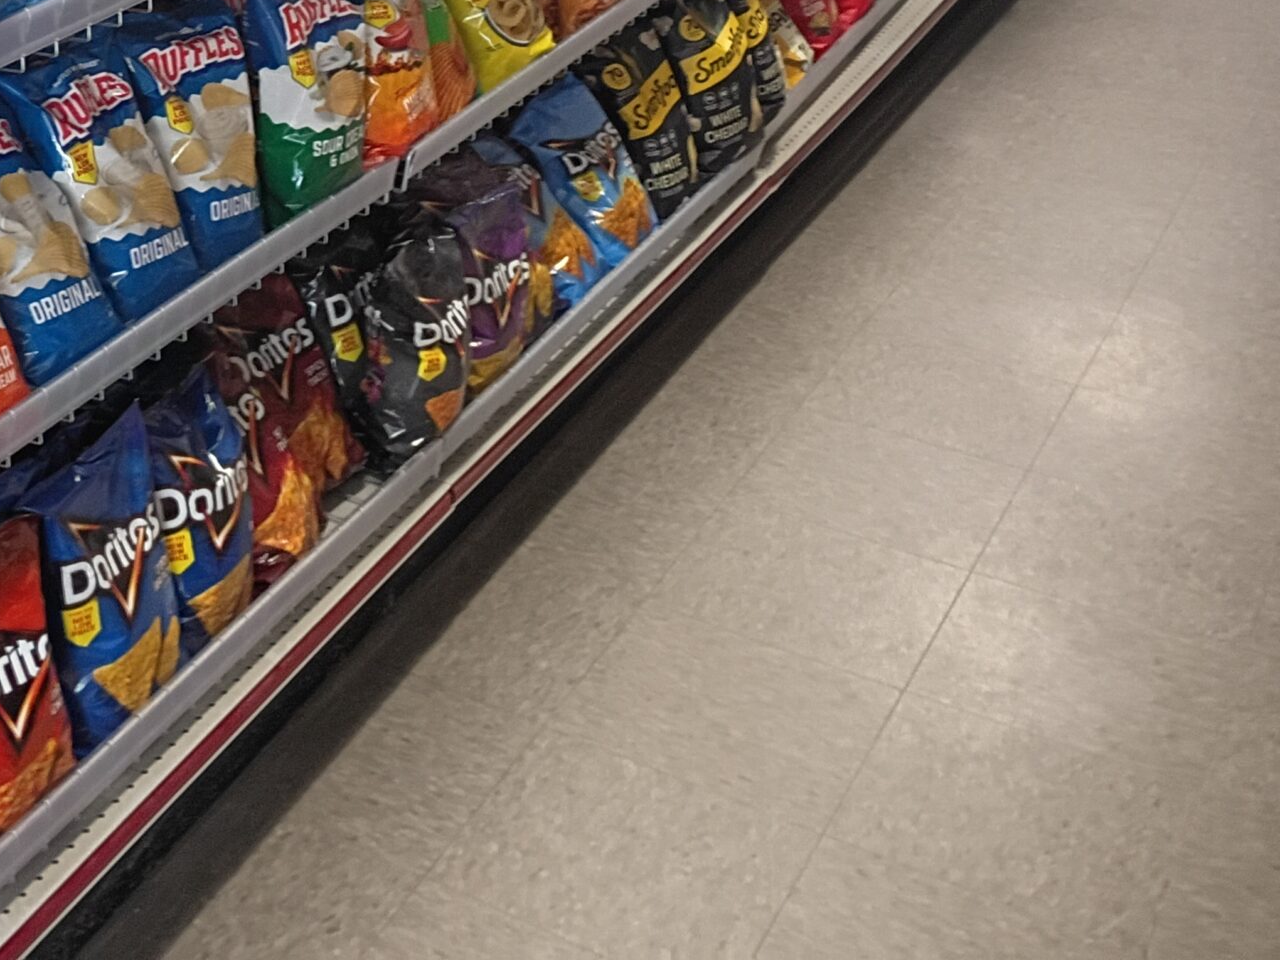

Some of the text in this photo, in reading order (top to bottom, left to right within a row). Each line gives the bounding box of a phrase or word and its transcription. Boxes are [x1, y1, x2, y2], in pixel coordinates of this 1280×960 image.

[139, 26, 245, 95] RUFFLES
[313, 135, 343, 157] SOUR
[130, 227, 189, 269] ORIGINAL
[29, 278, 101, 325] ORIGINAL
[61, 503, 161, 606] Doritos
